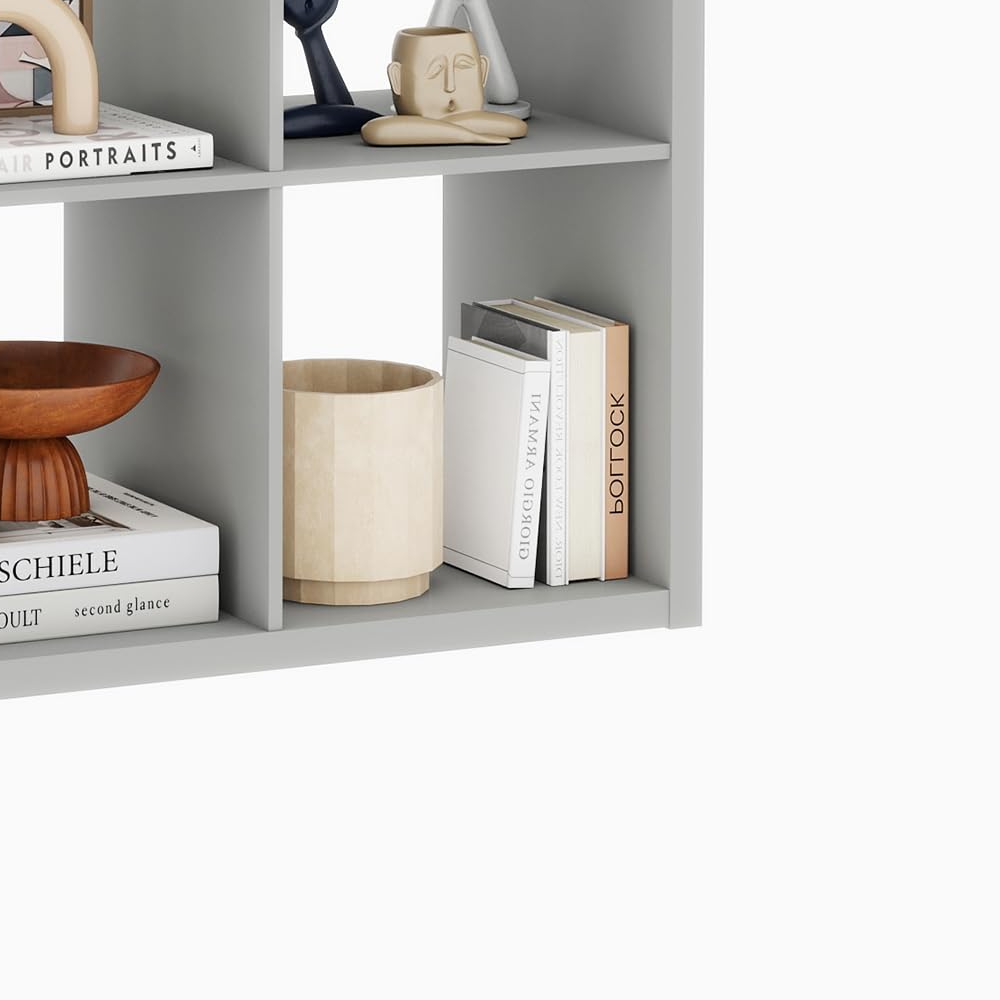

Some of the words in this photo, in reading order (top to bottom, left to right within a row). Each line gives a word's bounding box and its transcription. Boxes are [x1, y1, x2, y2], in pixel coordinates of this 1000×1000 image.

[45, 140, 177, 171] PORTRAITS
[74, 599, 121, 618] second
[126, 596, 170, 617] glance
